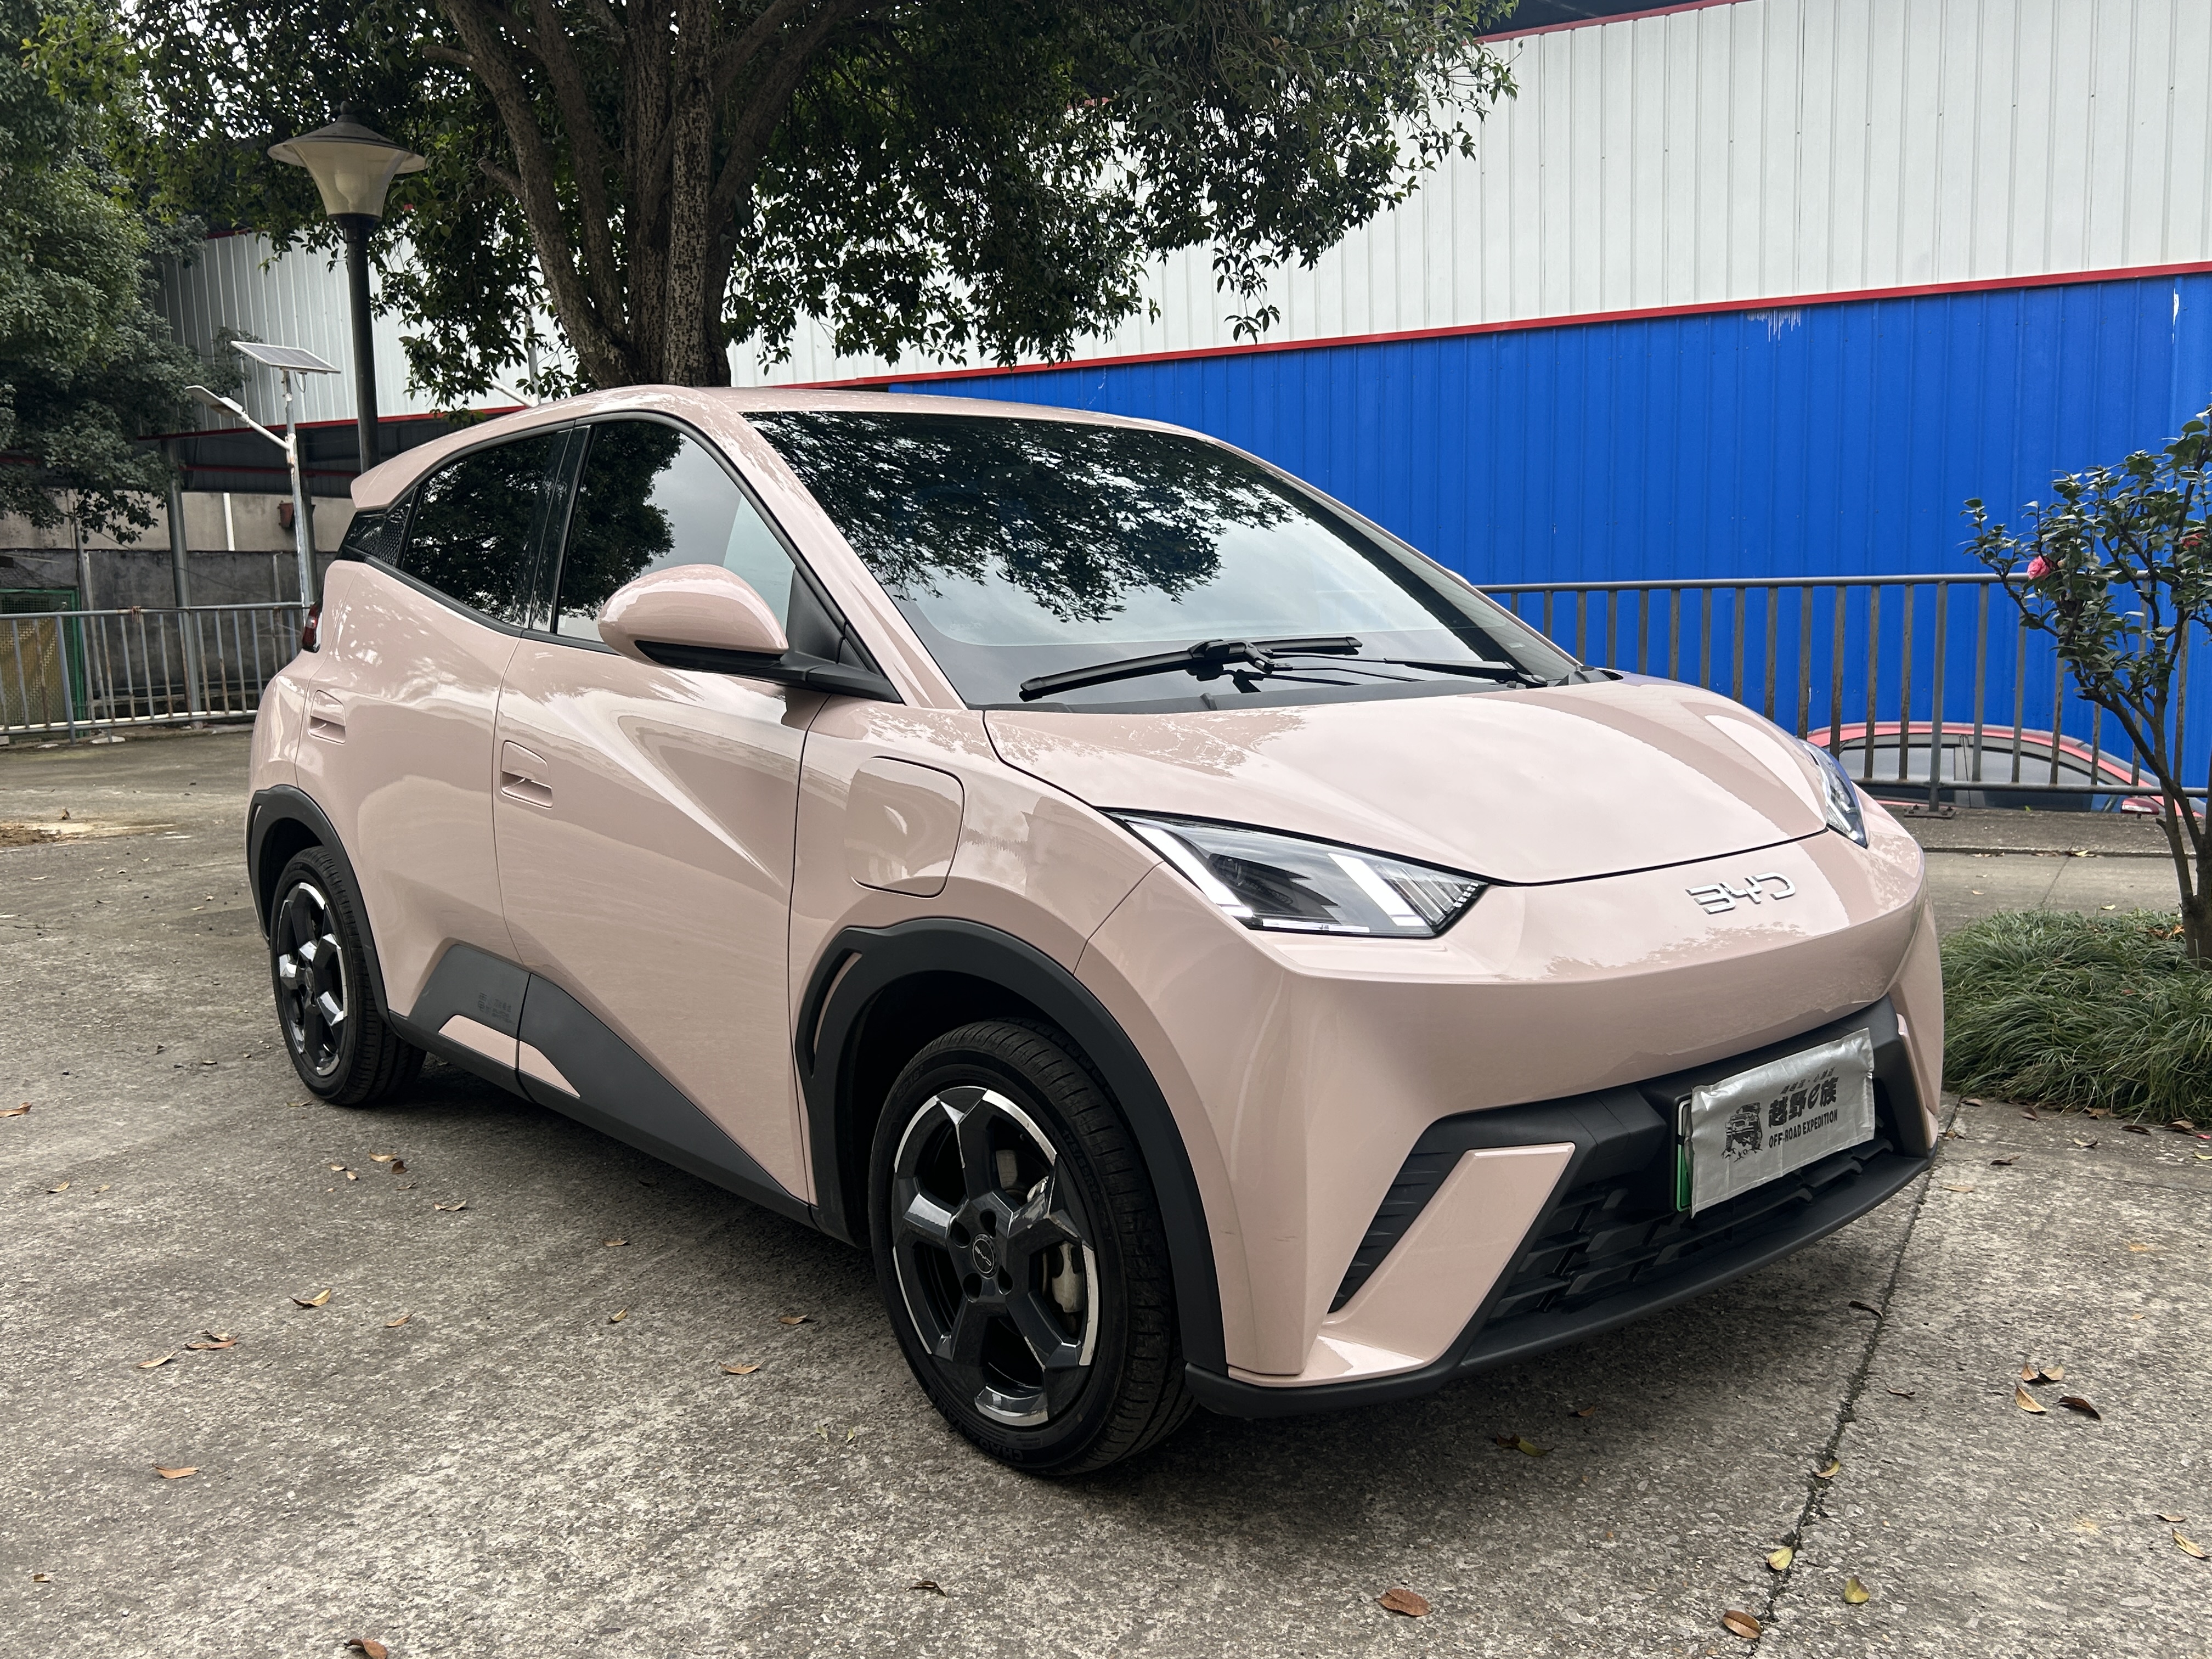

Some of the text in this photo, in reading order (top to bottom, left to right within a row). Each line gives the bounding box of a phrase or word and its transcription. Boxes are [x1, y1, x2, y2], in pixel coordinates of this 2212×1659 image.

[1685, 872, 1796, 915] BYD
[1769, 1109, 1838, 1148] OFF-ROAD EXPEDITION
